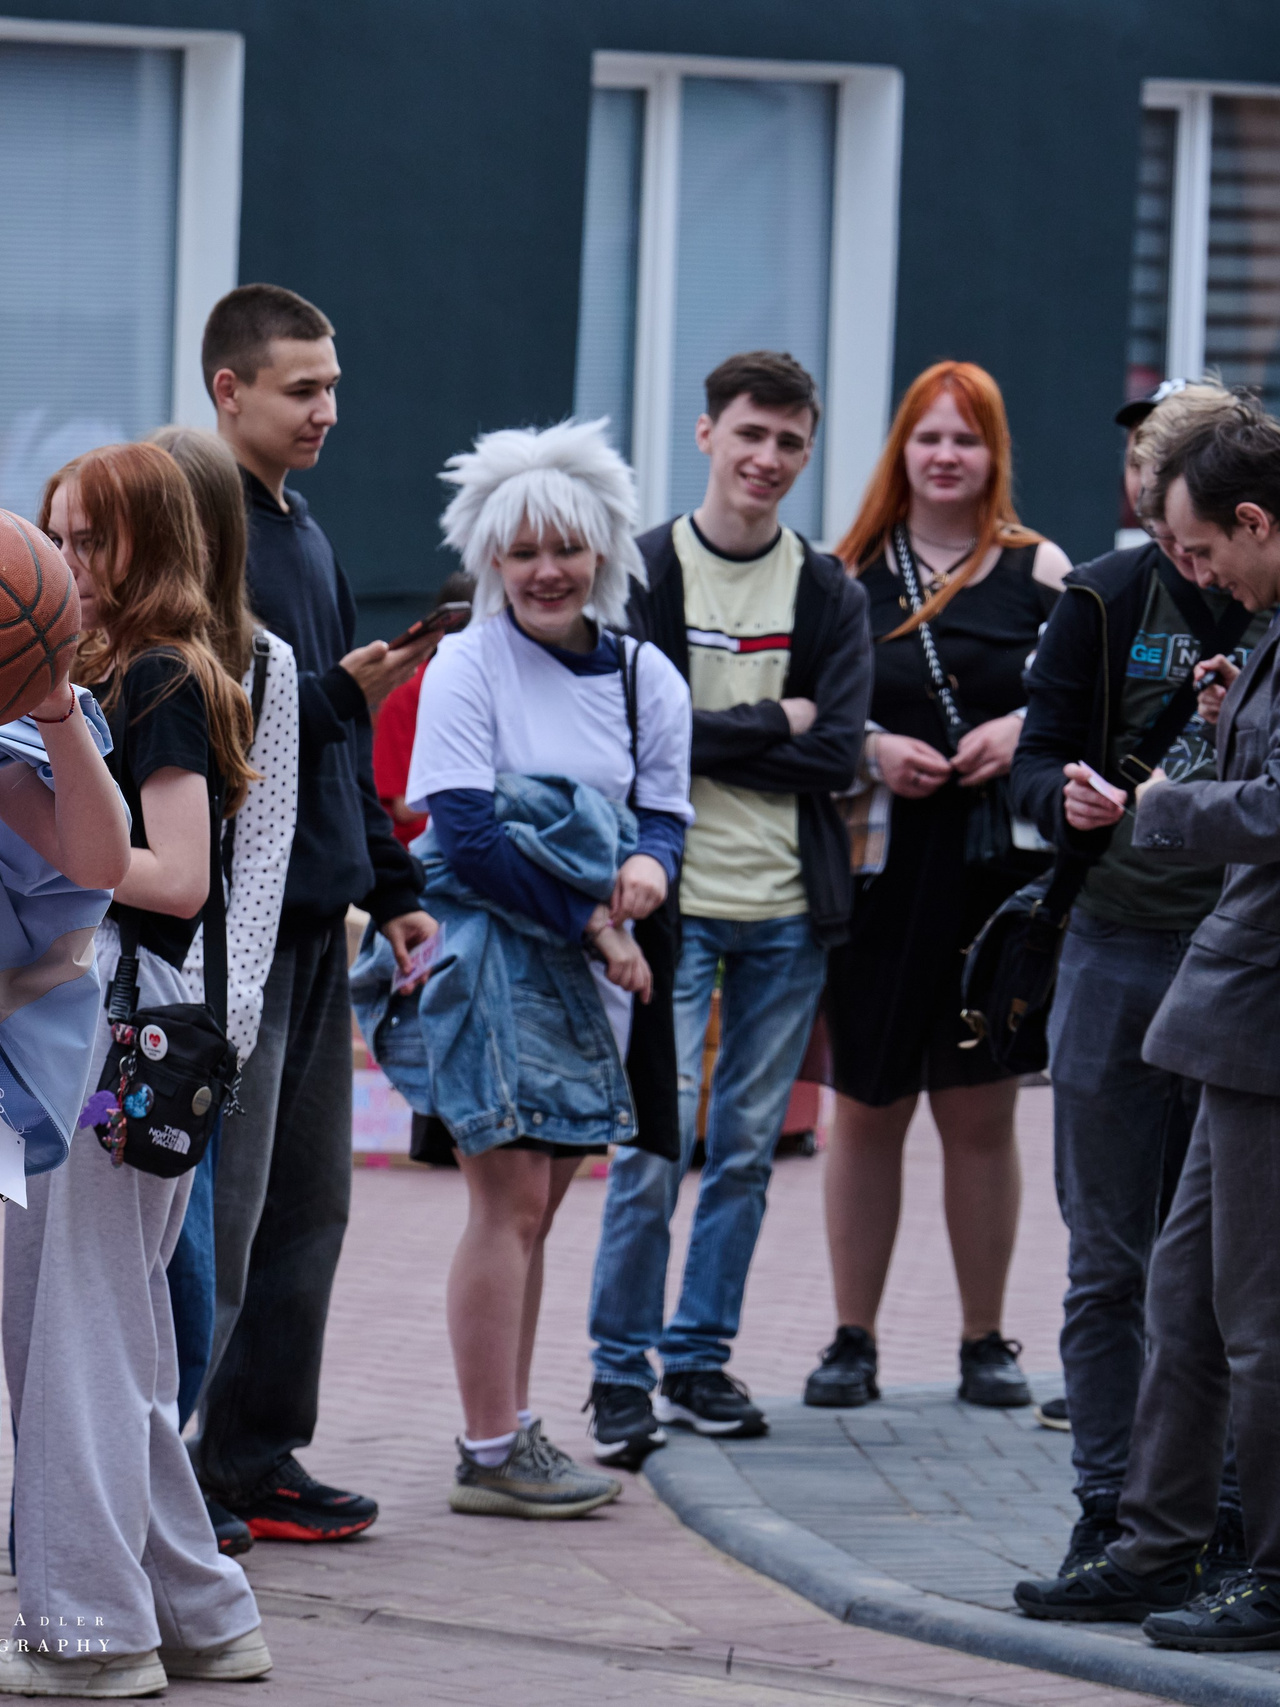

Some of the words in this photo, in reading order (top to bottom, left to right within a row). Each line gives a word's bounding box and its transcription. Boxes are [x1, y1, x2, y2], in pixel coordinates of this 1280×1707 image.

[148, 1127, 178, 1144] NORTH
[164, 1124, 179, 1137] THE
[151, 1136, 175, 1150] FACE
